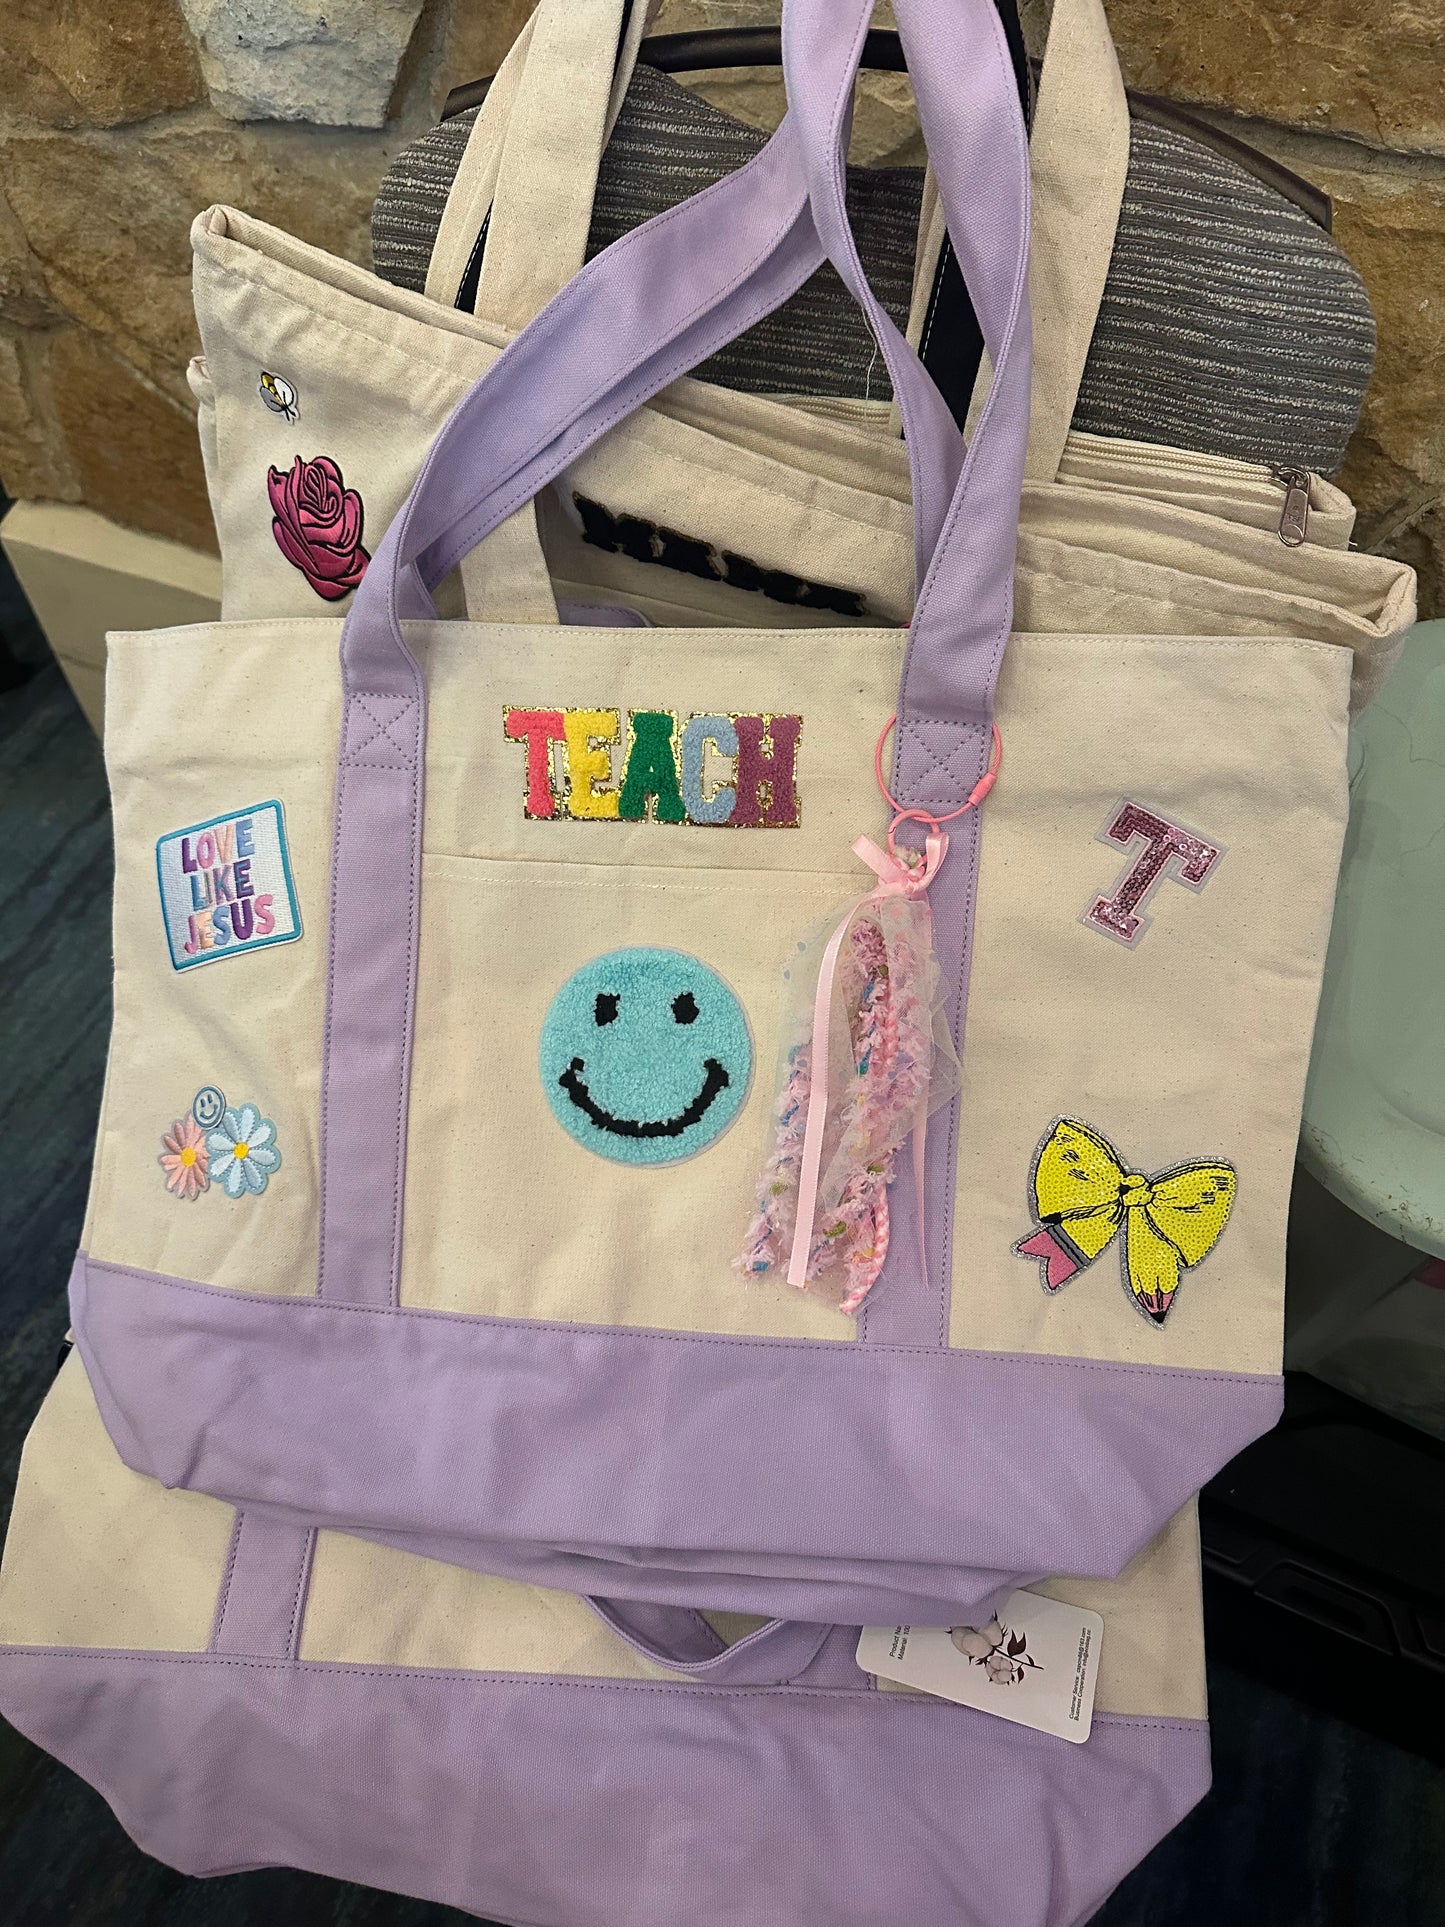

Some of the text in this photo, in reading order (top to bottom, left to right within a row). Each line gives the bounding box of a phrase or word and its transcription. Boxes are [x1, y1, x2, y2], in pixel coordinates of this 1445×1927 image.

[503, 705, 802, 828] TEACH
[181, 819, 255, 874] LOVE
[1086, 801, 1221, 942] T
[190, 859, 255, 912] LIKE
[184, 894, 276, 954] JESUS
[889, 1636, 900, 1658] Product
[1069, 1695, 1077, 1719] Customer
[1074, 1698, 1082, 1721] Business
